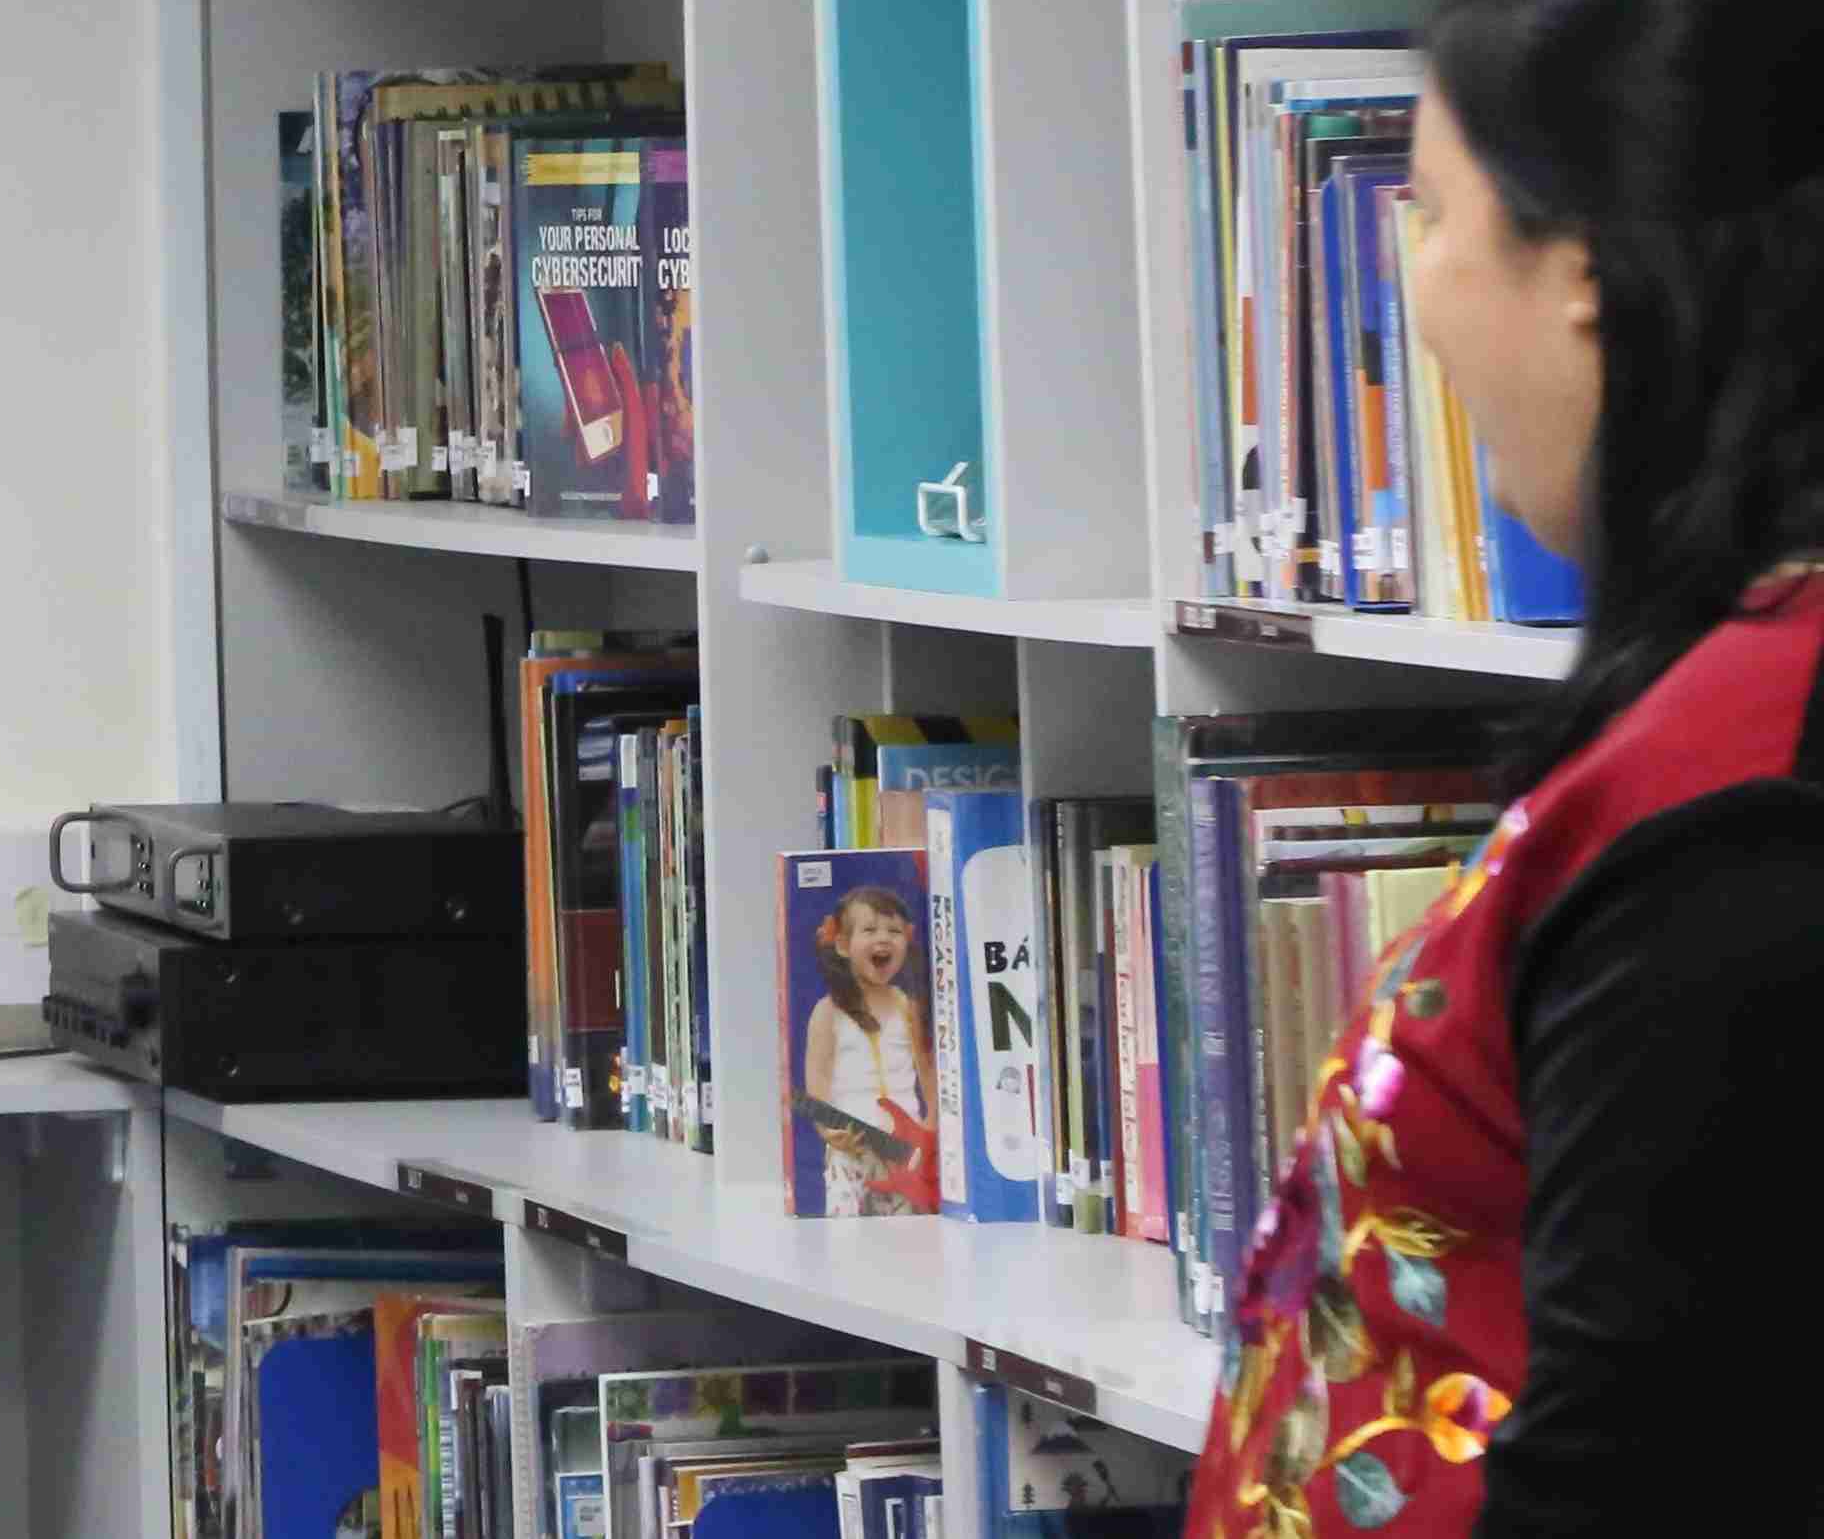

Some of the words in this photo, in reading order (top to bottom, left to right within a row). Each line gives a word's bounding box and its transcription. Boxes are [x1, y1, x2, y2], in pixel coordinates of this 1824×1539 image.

[539, 225, 572, 250] YOUR
[575, 225, 641, 250] PERSONAL
[532, 255, 642, 287] CYBERSECURIT
